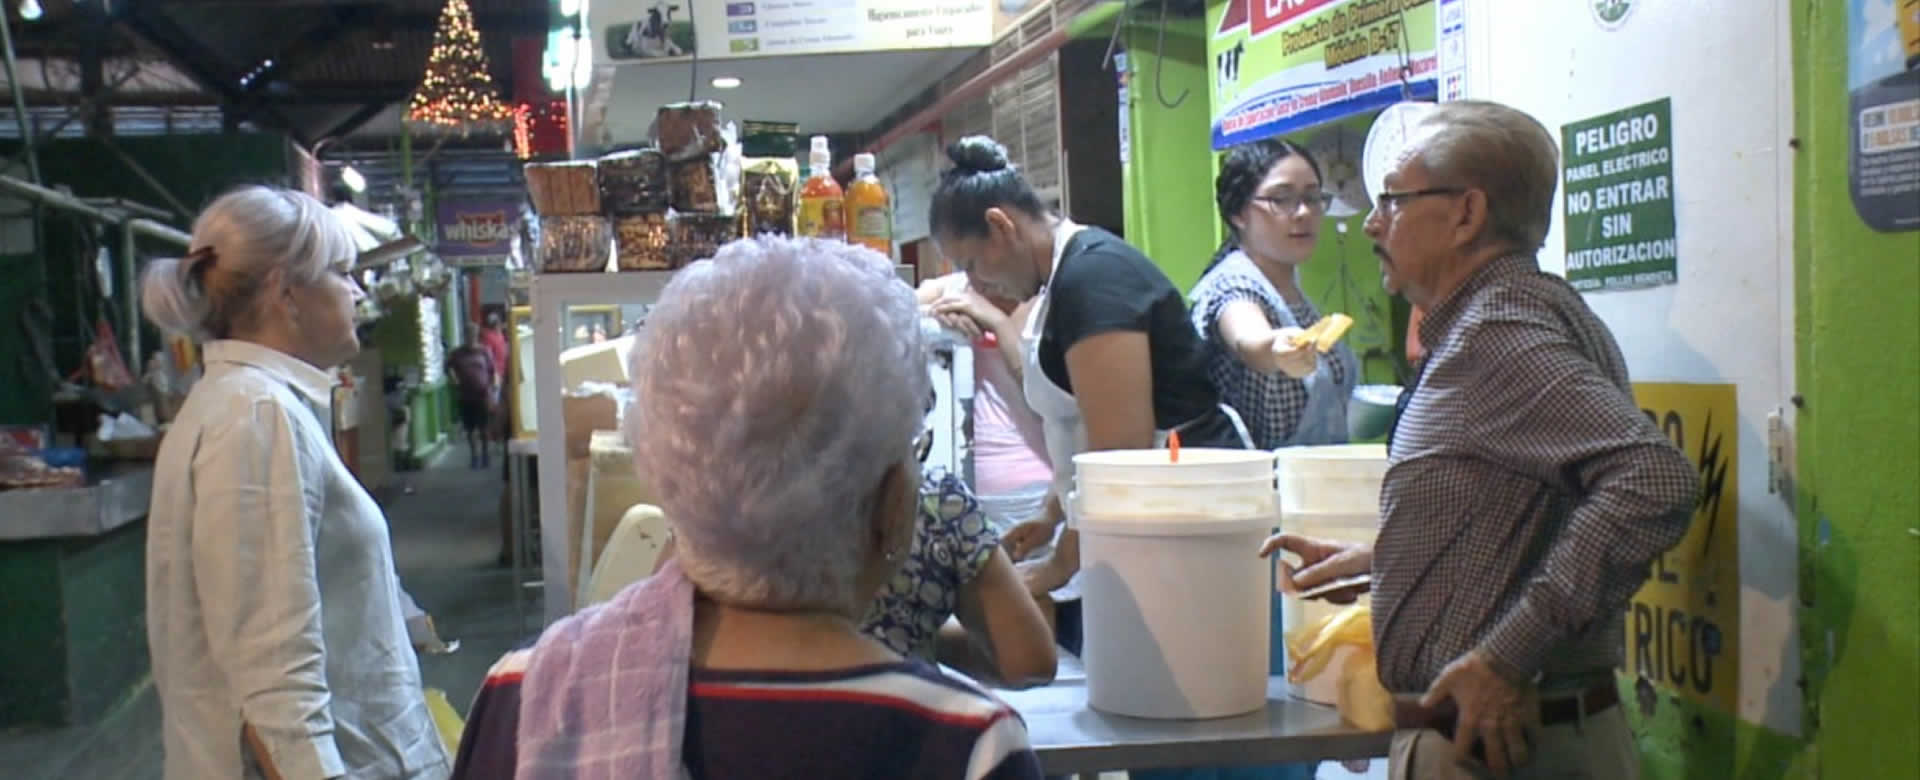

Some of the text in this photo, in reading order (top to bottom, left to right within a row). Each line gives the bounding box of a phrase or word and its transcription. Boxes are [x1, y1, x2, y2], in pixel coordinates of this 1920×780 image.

[1281, 17, 1330, 56] Producto
[1575, 114, 1658, 156] PELIGRO
[1566, 147, 1669, 184] PANEL ELECTRICO
[1567, 176, 1668, 216] NO ENTRAR
[1602, 212, 1632, 239] SIN
[1567, 238, 1675, 271] AUTORIZACION
